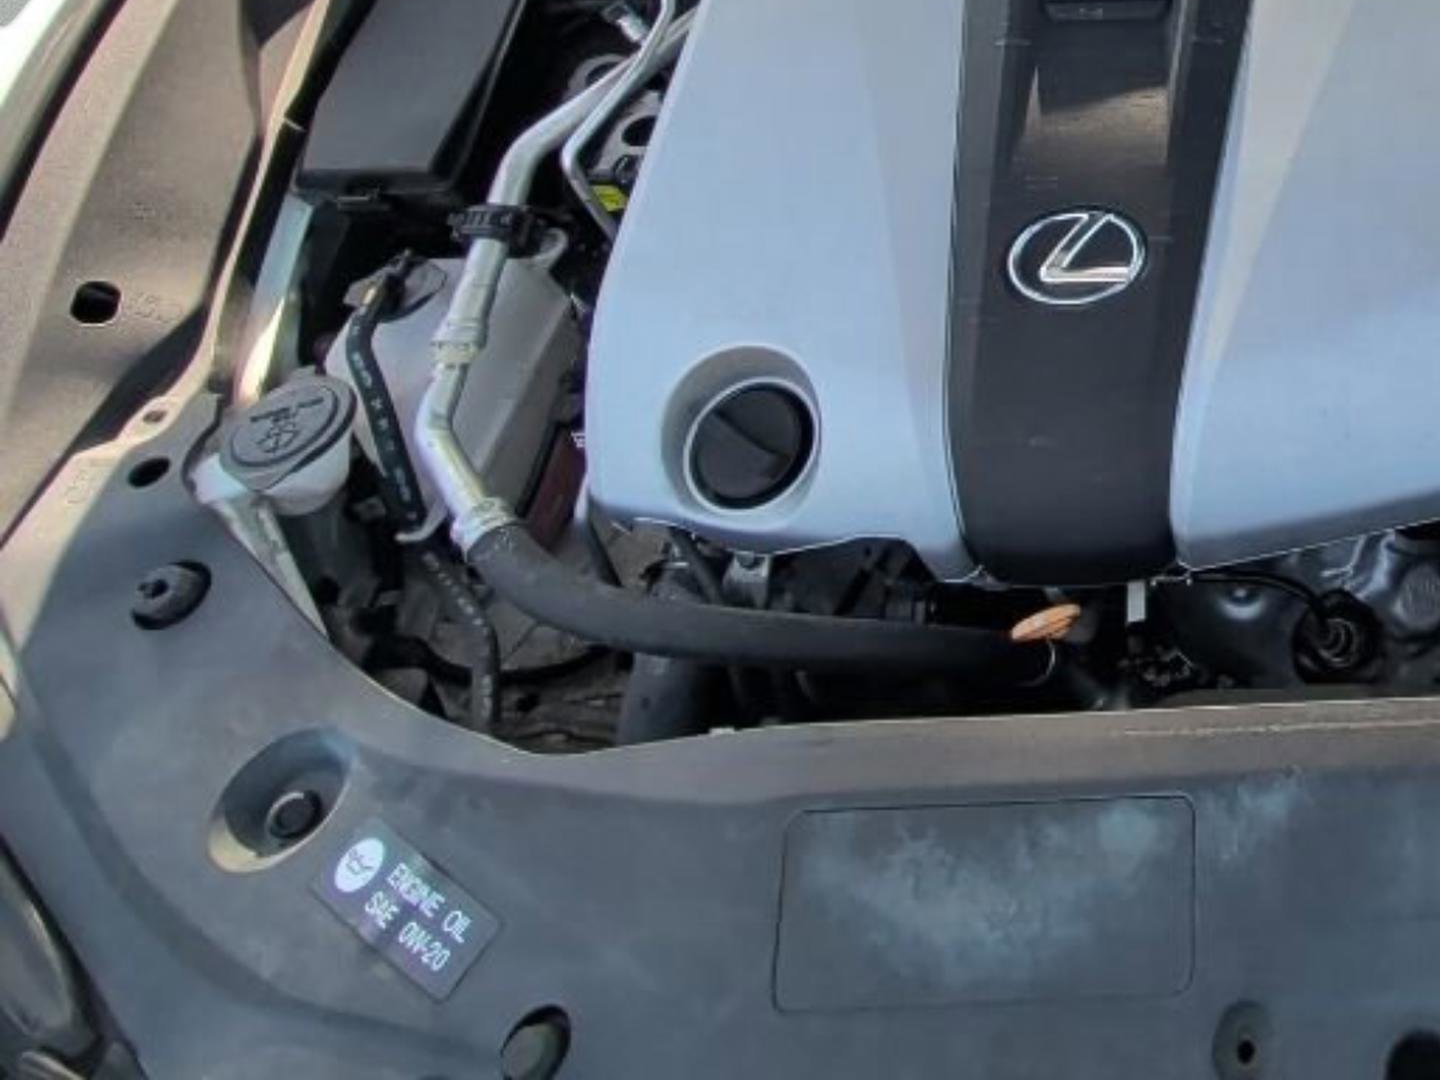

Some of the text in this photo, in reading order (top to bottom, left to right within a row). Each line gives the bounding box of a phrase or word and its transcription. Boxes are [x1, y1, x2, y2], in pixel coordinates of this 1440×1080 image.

[364, 890, 451, 971] SAE 0W-20
[386, 862, 472, 944] ENGINE OIL
